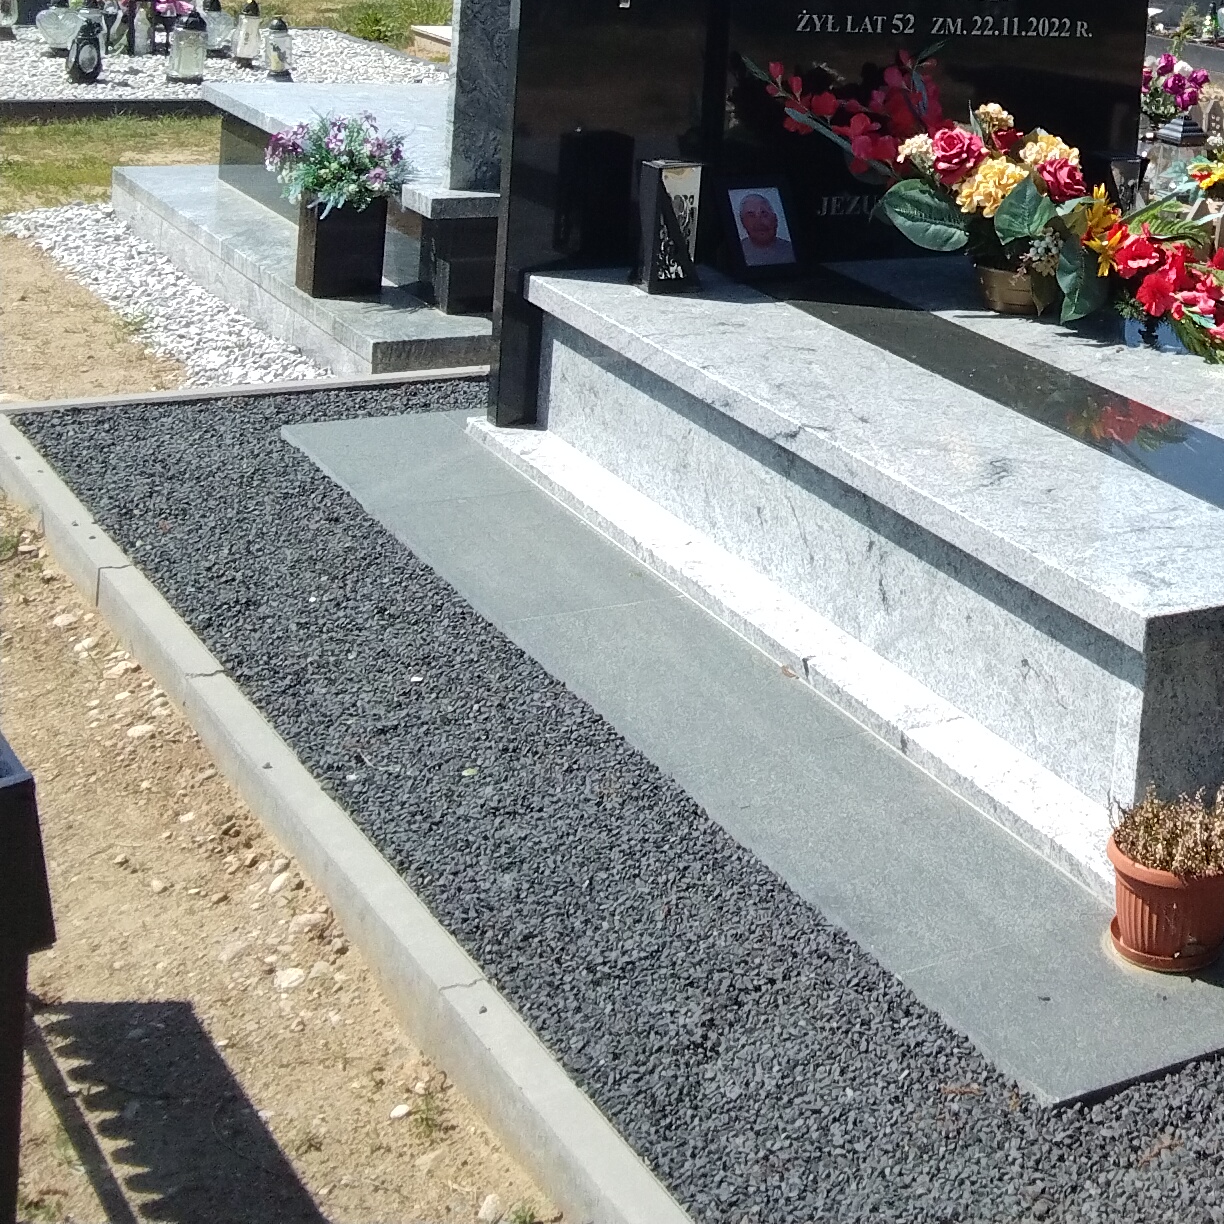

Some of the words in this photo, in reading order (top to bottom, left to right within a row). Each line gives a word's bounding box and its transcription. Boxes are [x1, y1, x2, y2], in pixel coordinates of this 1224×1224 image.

[796, 9, 840, 33] ŻYŁ
[846, 15, 887, 33] LAT
[892, 13, 915, 34] 52
[930, 17, 968, 36] ZM.
[971, 15, 1071, 38] 22.11.2022
[1076, 21, 1094, 38] R.
